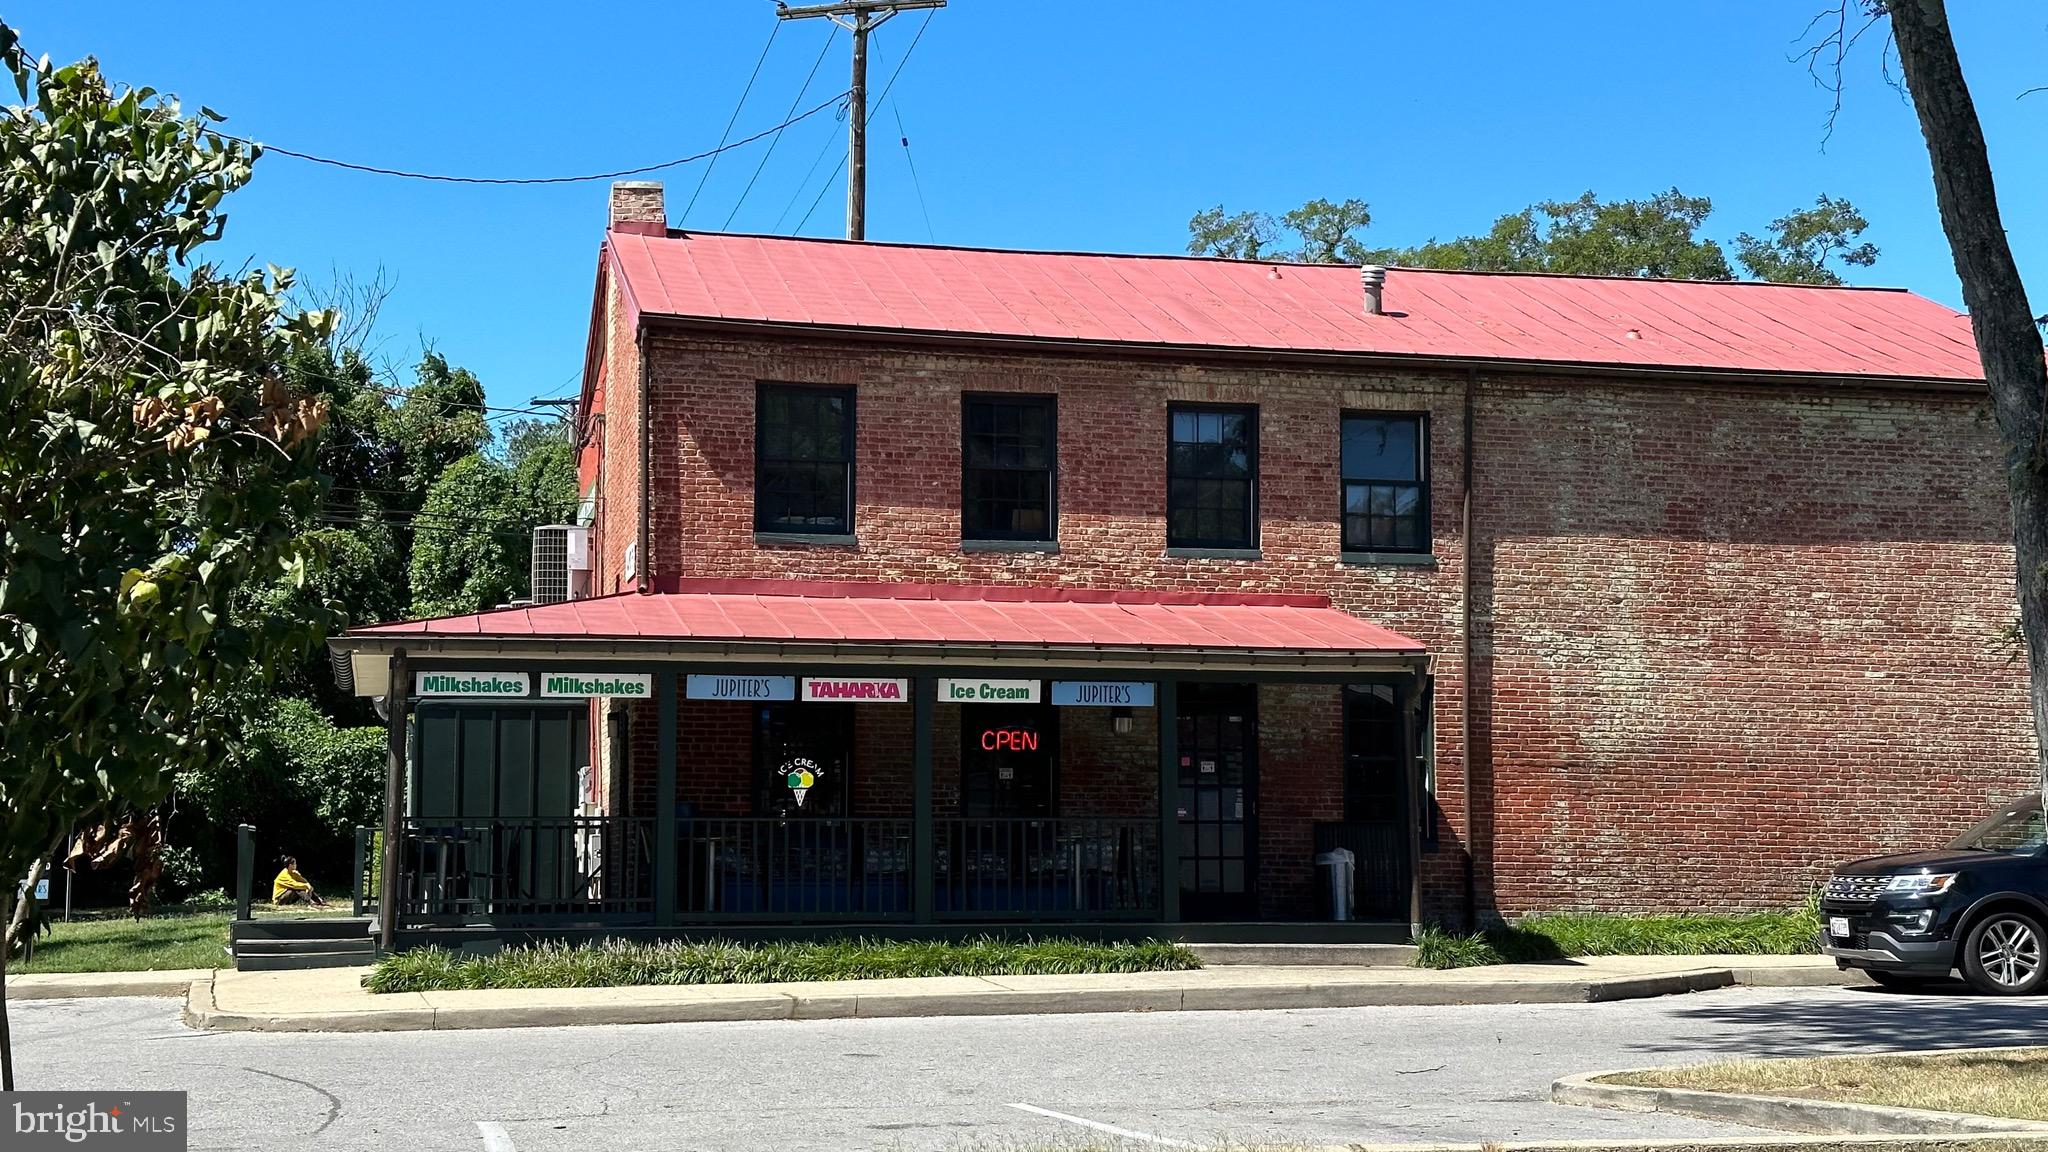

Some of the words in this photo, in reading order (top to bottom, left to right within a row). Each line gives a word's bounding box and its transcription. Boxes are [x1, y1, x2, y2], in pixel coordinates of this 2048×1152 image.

[423, 675, 523, 694] Milkshakes
[548, 677, 645, 695] Milkshakes
[712, 678, 771, 698] JUPITER'S
[809, 682, 900, 699] TAHARKA
[950, 682, 975, 699] Ice
[979, 682, 1030, 700] Cream
[1075, 684, 1131, 704] JUPITER'S
[777, 761, 793, 776] ICE
